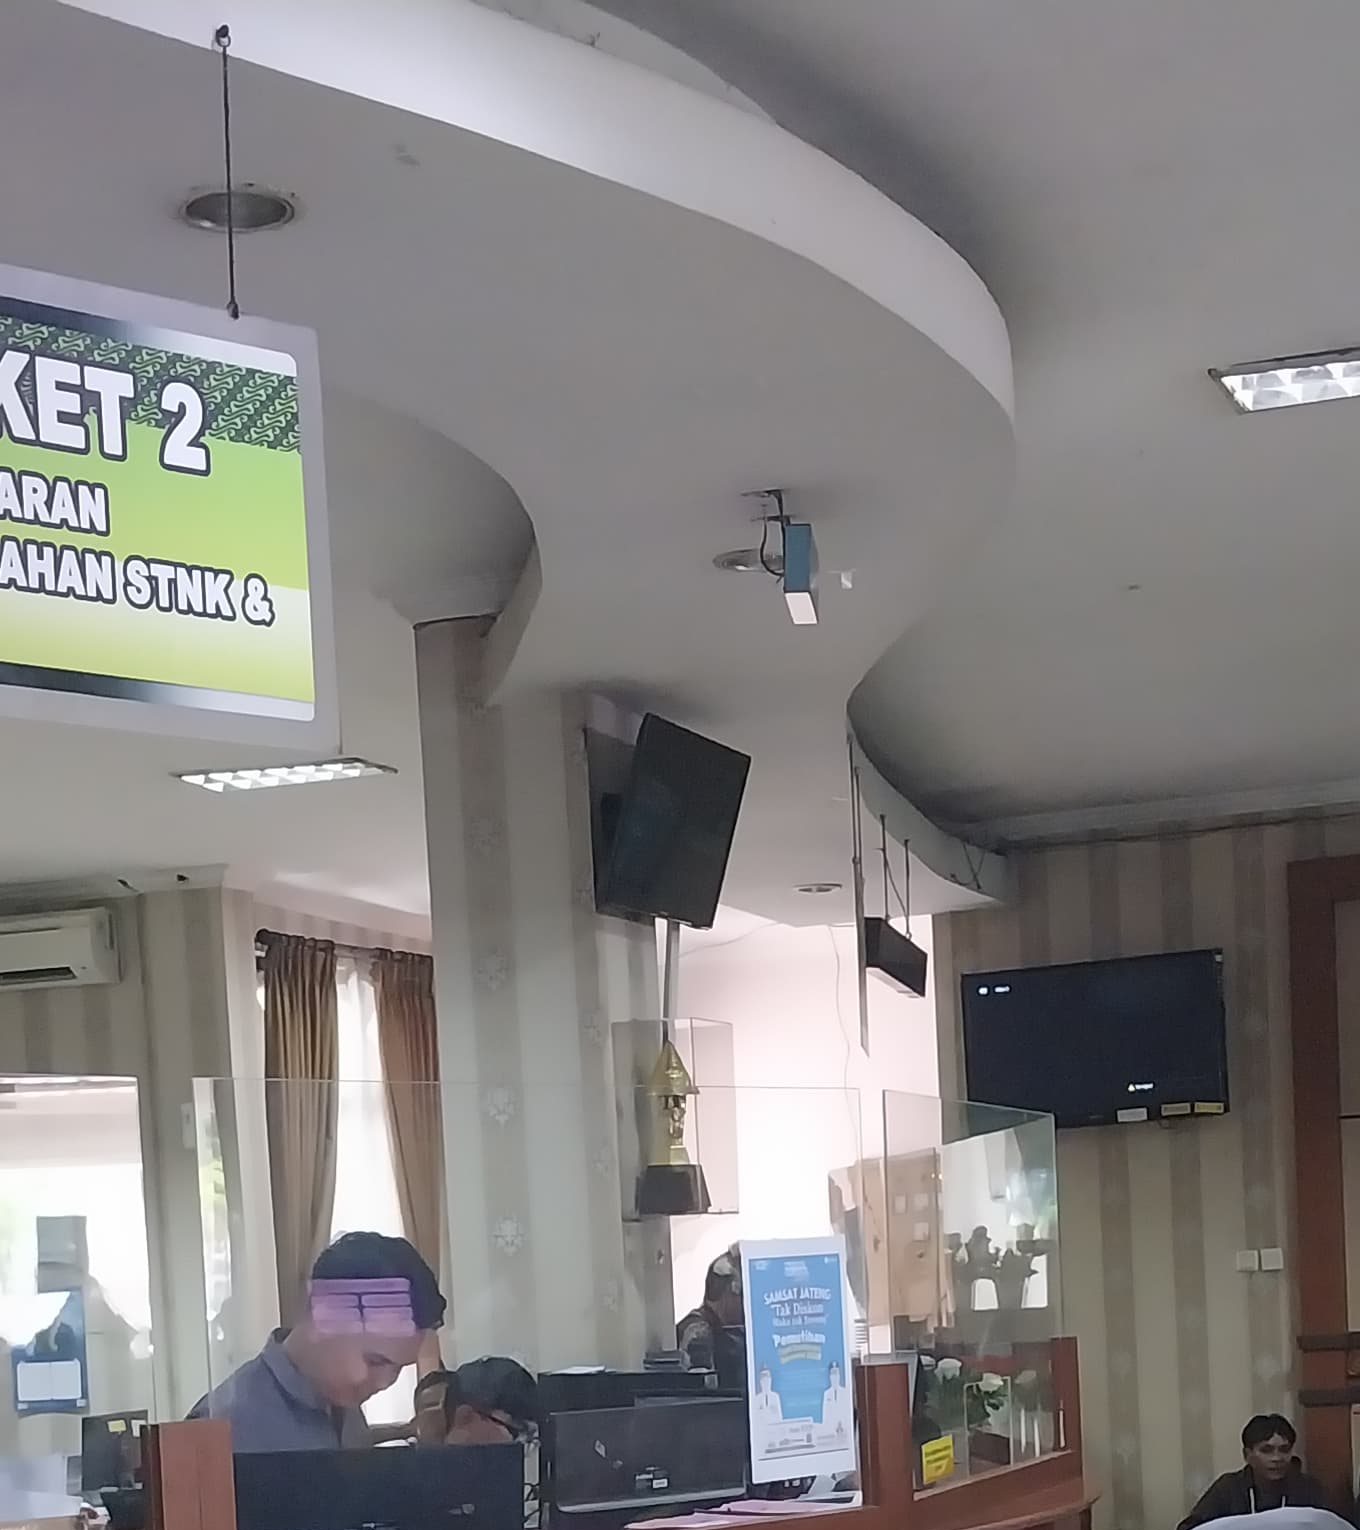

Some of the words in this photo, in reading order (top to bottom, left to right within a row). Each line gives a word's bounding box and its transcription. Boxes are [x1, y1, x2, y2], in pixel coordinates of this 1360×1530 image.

[158, 379, 211, 475] 2
[122, 559, 238, 619] STNK
[242, 574, 275, 625] &
[763, 1288, 798, 1305] SAMSAT
[800, 1287, 832, 1300] JATENG
